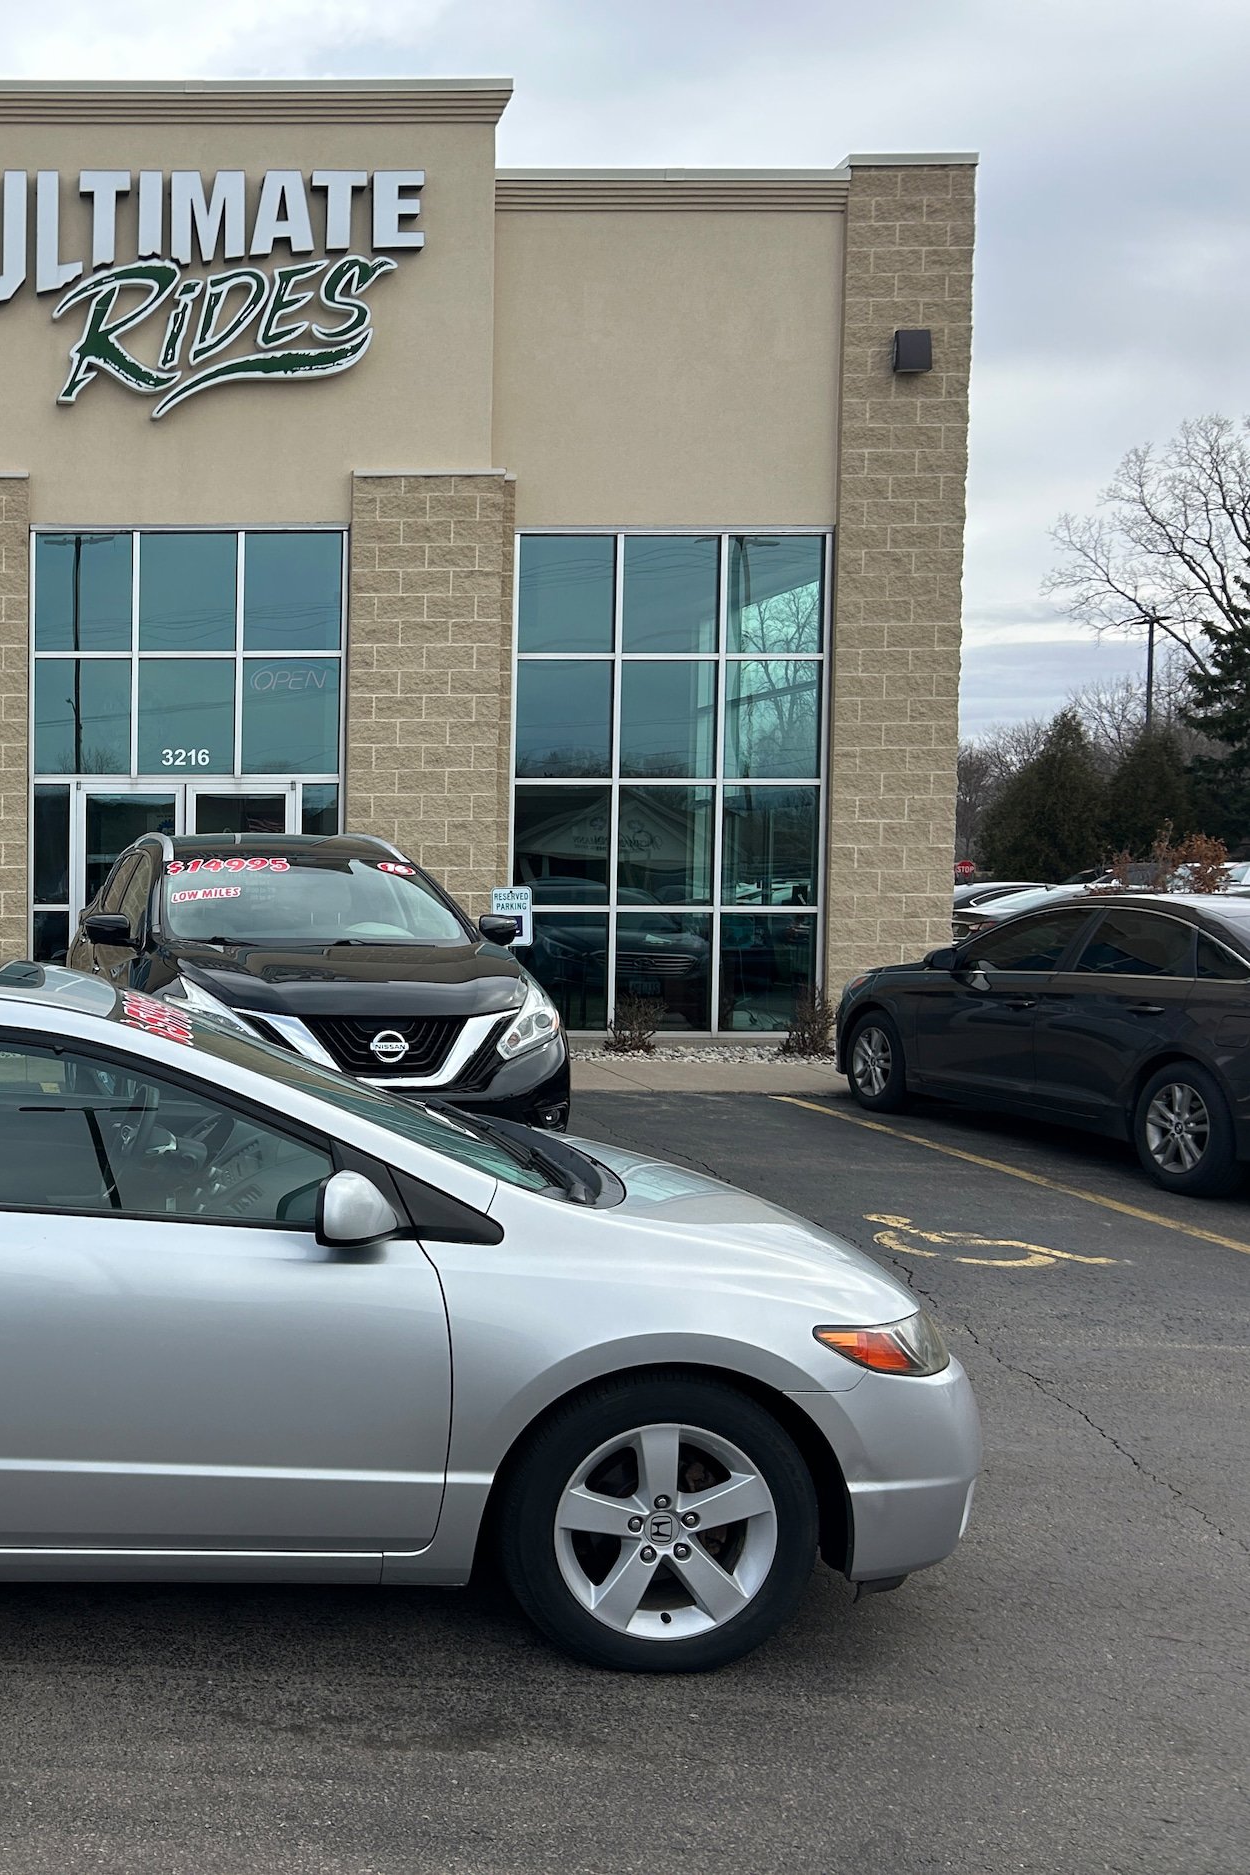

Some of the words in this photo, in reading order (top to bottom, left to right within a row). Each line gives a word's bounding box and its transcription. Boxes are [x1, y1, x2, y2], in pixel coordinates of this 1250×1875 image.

[254, 670, 327, 691] OPEN
[161, 748, 210, 766] 3216
[167, 858, 290, 875] $14995
[956, 865, 975, 874] STOP
[172, 890, 199, 903] LOW
[201, 886, 240, 900] MILES
[494, 892, 529, 901] RESERVED
[496, 902, 527, 911] PARKING
